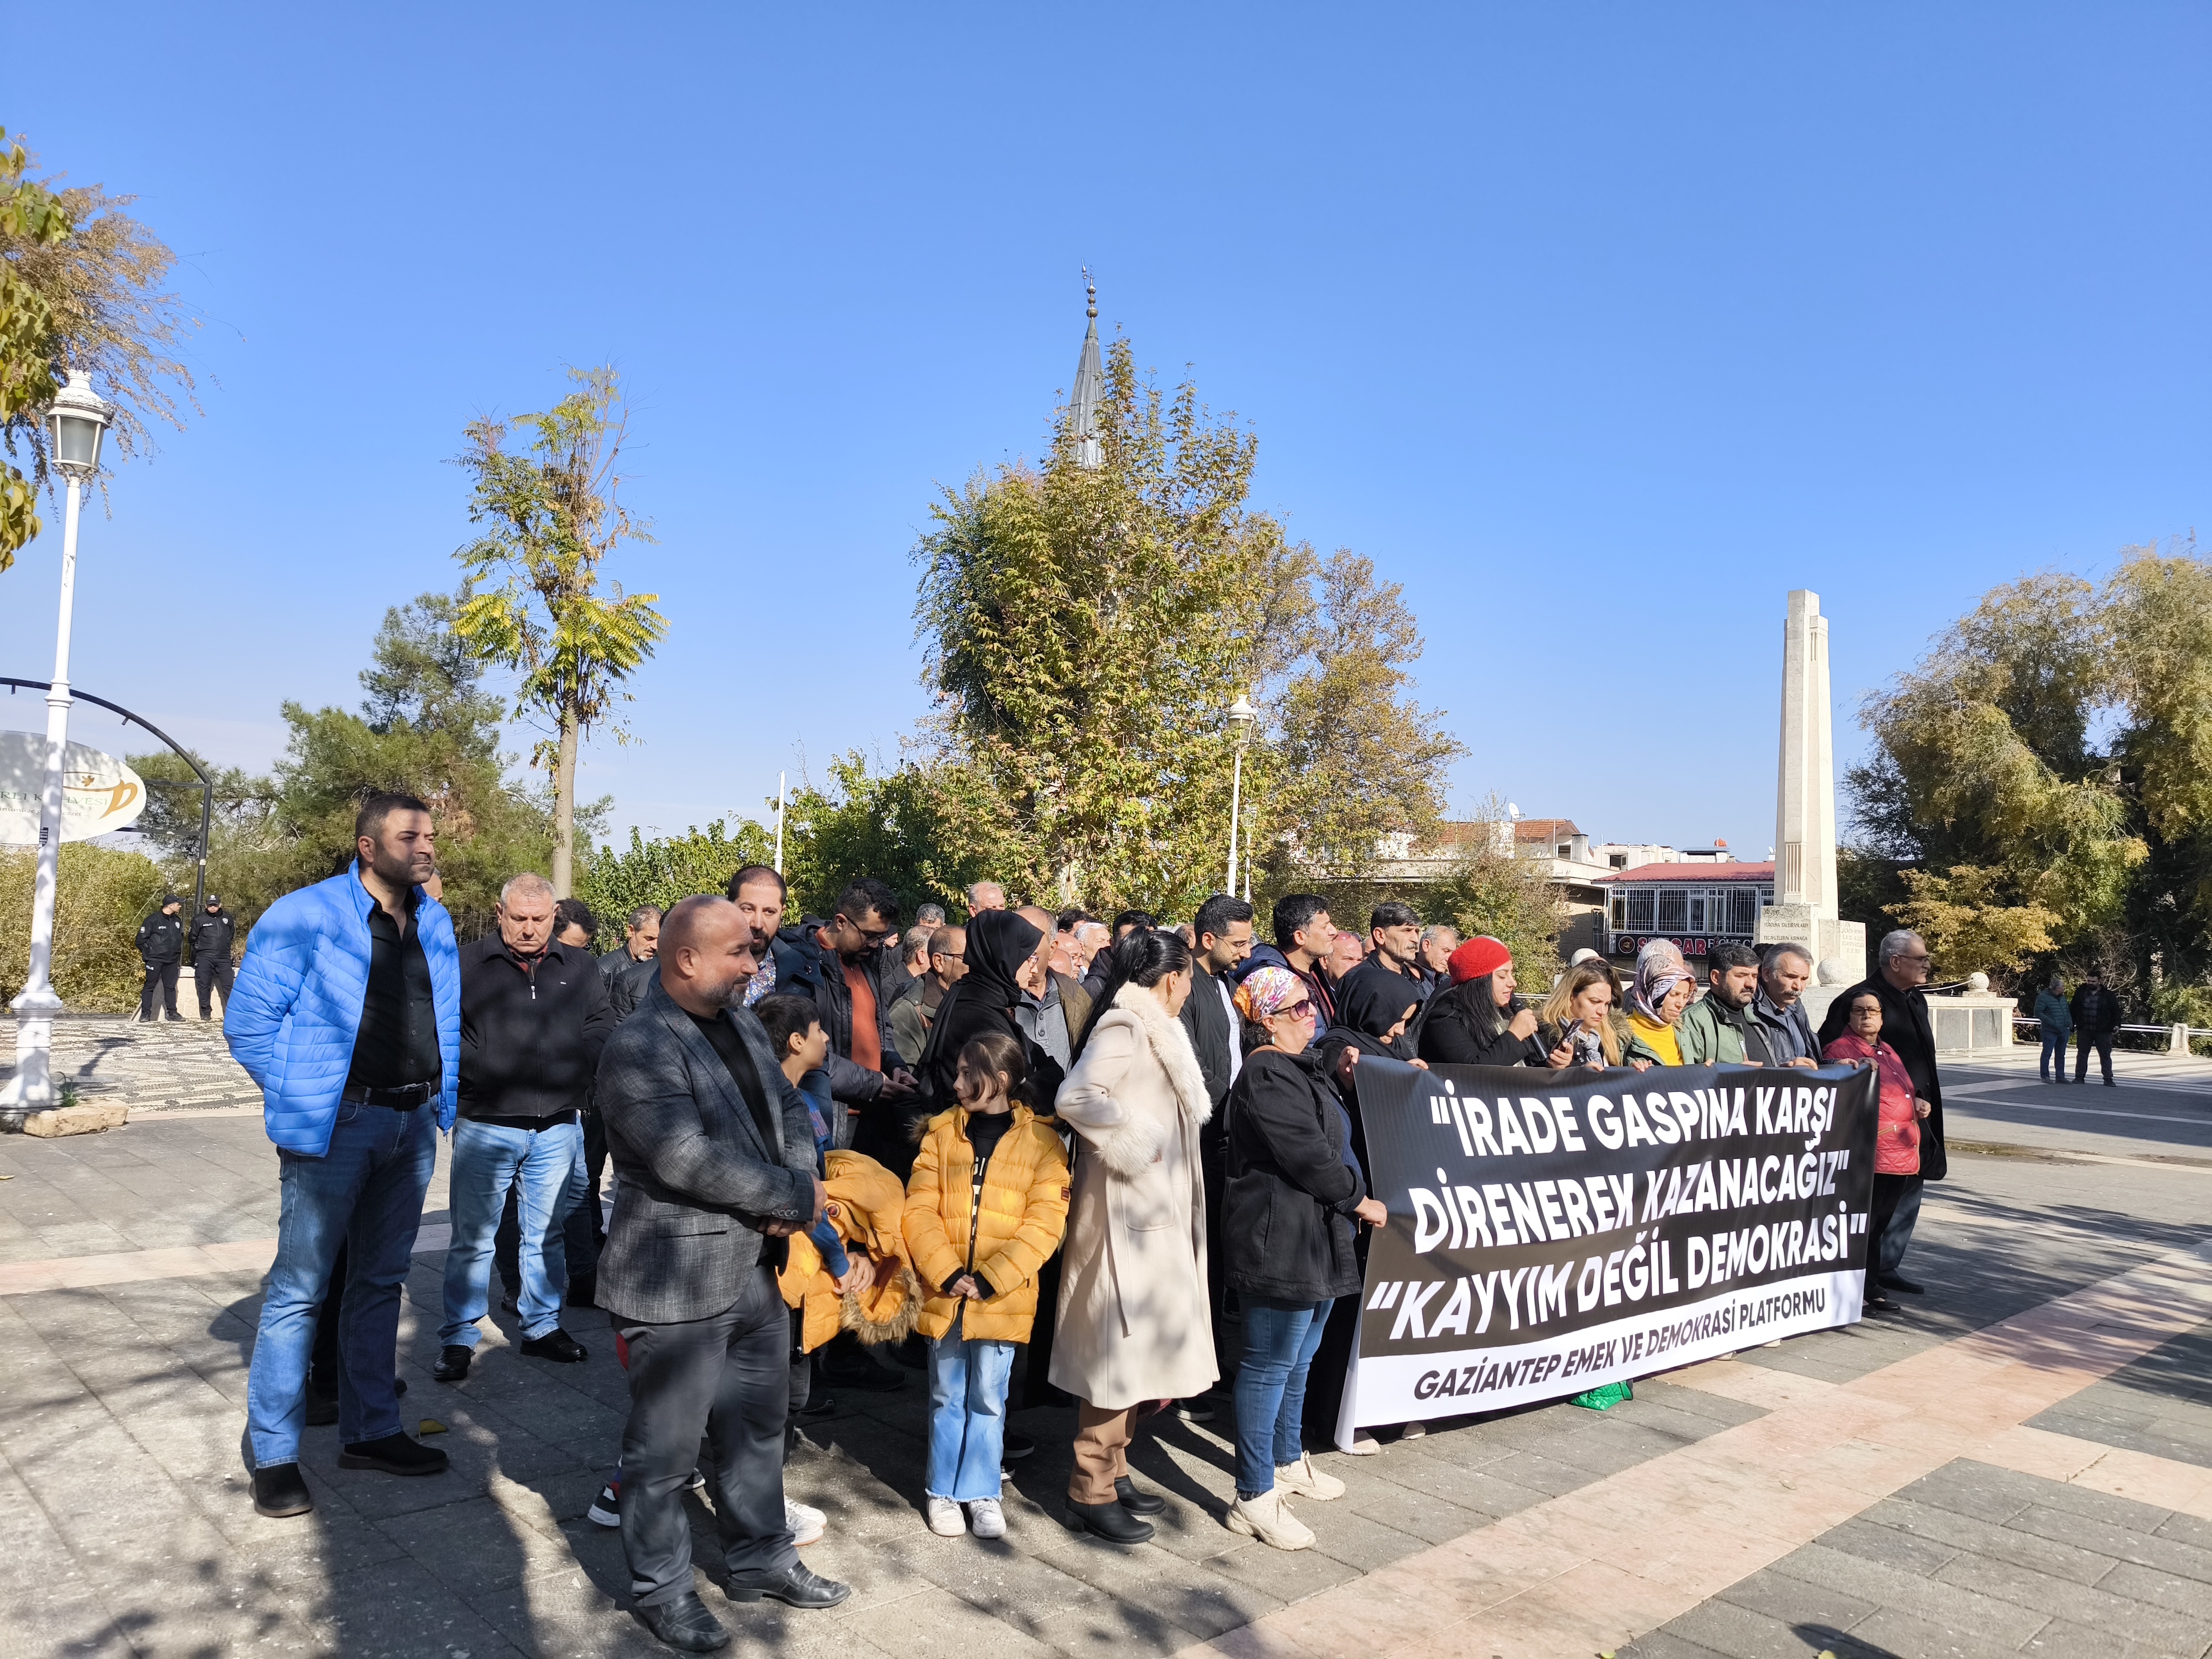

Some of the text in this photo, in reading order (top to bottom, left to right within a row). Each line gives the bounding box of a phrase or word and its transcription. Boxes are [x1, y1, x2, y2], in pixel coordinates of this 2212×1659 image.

[33, 794, 108, 806] KHVESİ
[1430, 1079, 1837, 1156] "İRADE GASPINA KARŞI
[1408, 1140, 1850, 1254] DİRENEREK KAZANACAĞIZ"
[1366, 1200, 1867, 1339] "KAYYIM DEĞİL DEMOKRASİ"
[1414, 1287, 1825, 1400] GAZİANTEP EMEK VE DEMOKRASİ PLATFORMU
